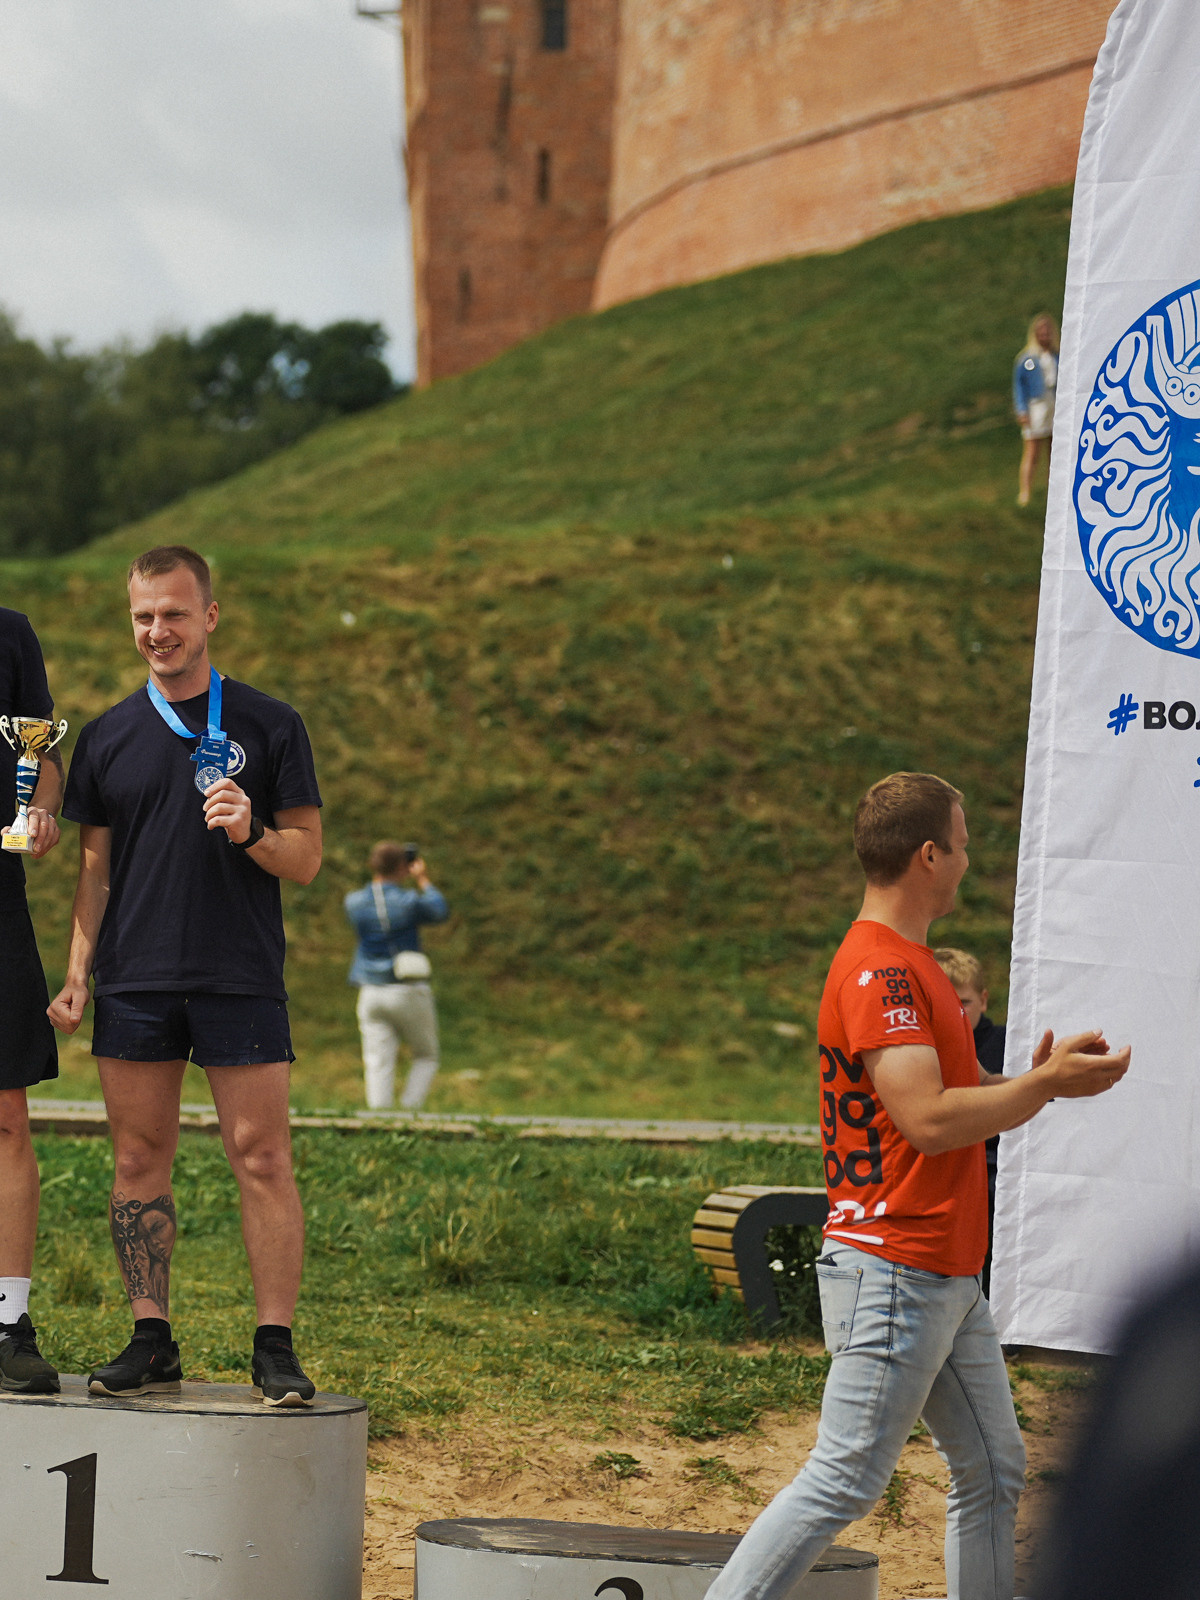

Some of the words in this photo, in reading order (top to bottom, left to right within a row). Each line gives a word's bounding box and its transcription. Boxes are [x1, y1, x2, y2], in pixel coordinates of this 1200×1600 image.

[1106, 693, 1200, 736] #ВО
[858, 966, 908, 987] #nov
[885, 978, 910, 994] go
[881, 990, 914, 1006] rod
[882, 1008, 918, 1026] TRI
[46, 1452, 110, 1585] 1
